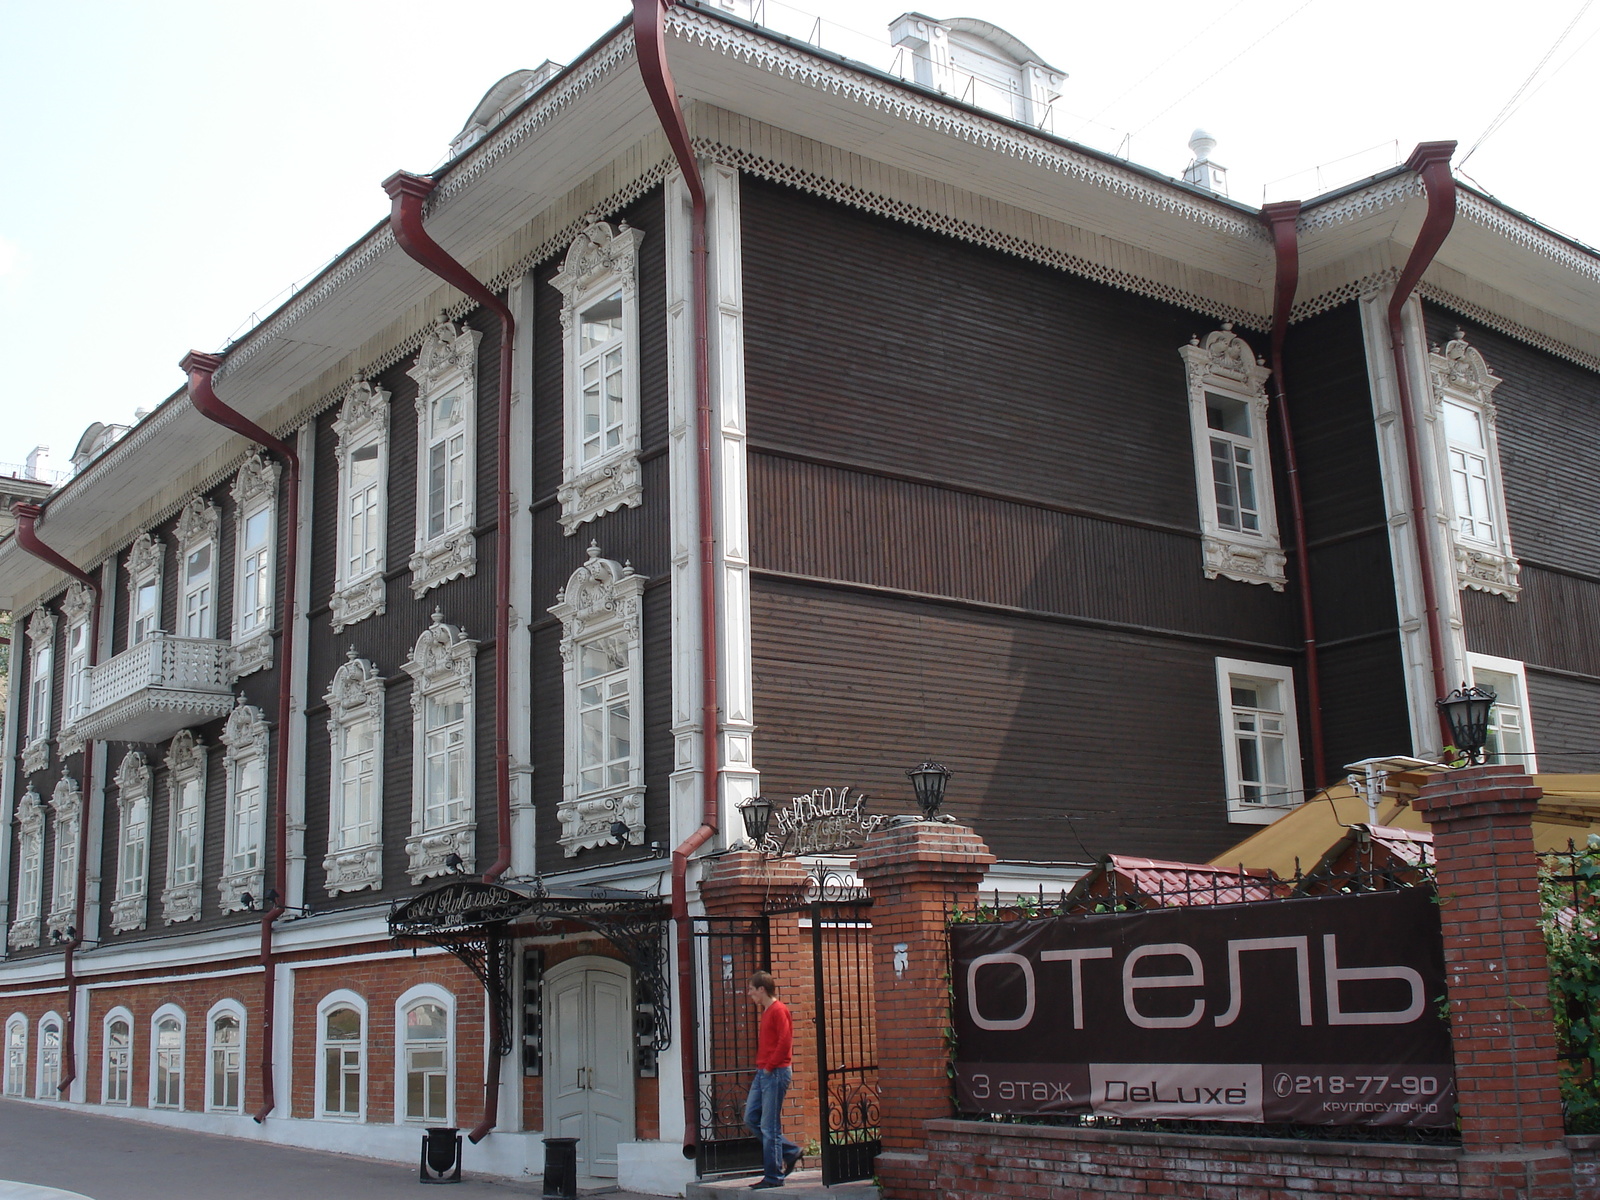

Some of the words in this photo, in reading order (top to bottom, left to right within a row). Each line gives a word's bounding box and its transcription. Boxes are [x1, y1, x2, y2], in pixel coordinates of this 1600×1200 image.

[971, 1074, 991, 1099] 3
[998, 1081, 1073, 1102] этаж
[1295, 1075, 1438, 1095] 218-77-90
